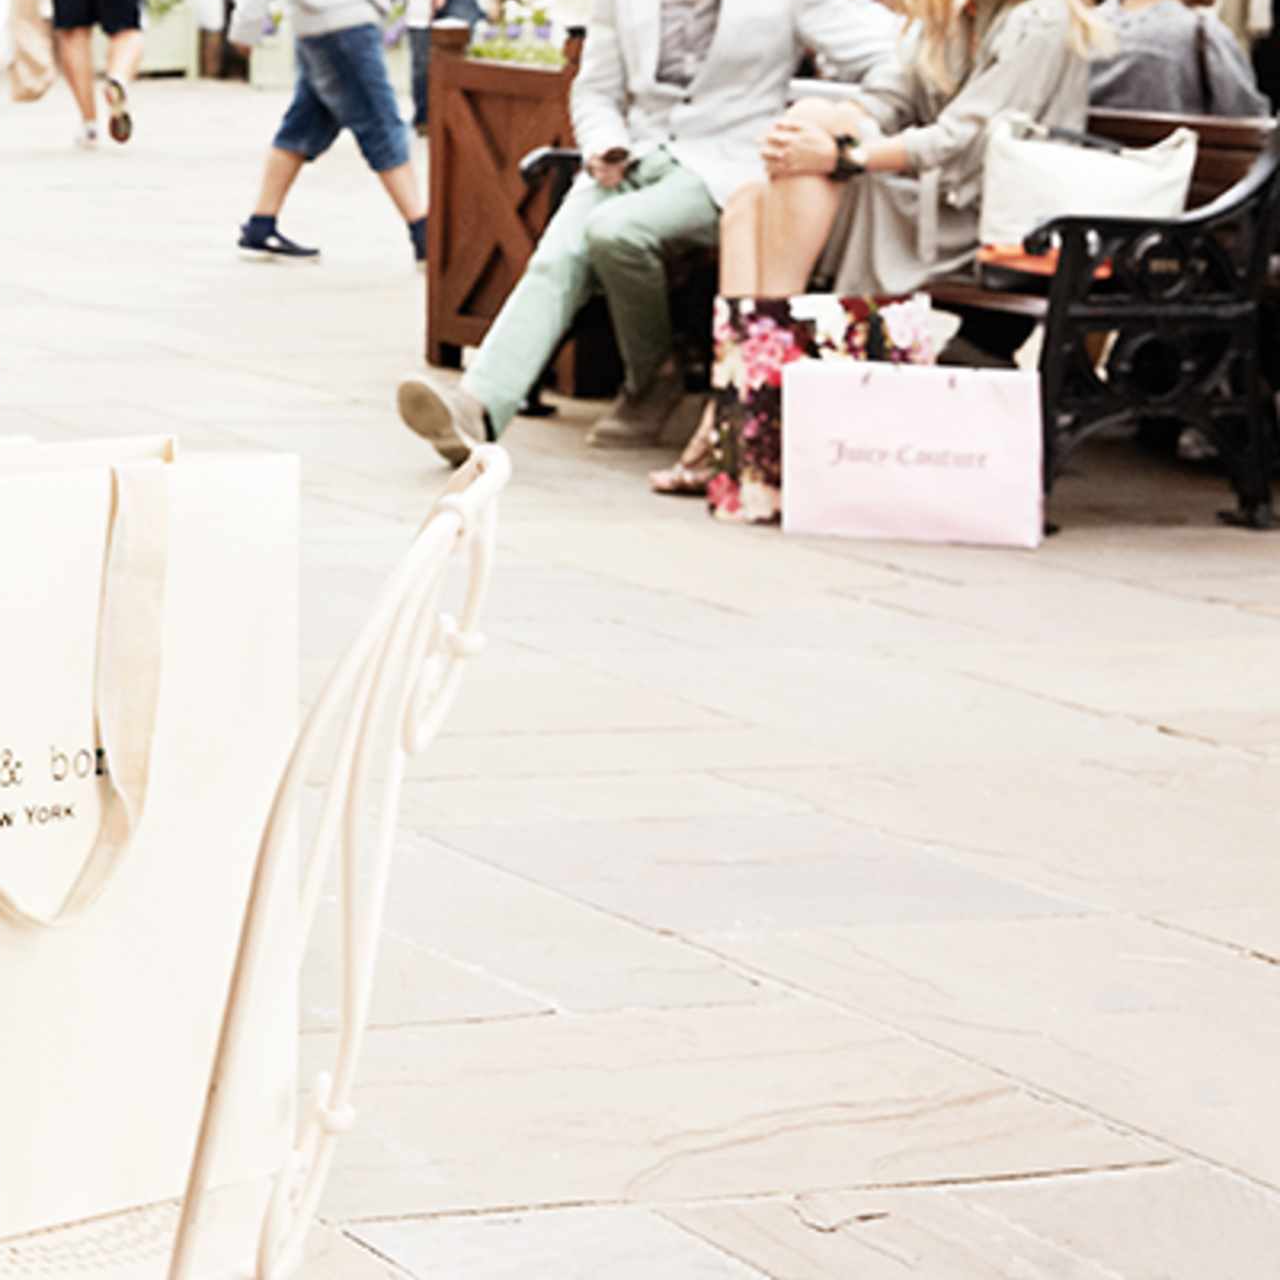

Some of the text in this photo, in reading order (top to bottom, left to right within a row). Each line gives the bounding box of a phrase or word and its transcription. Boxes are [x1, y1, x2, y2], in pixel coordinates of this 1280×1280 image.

[827, 439, 989, 469] Juicy Couture
[24, 802, 77, 825] YORK
